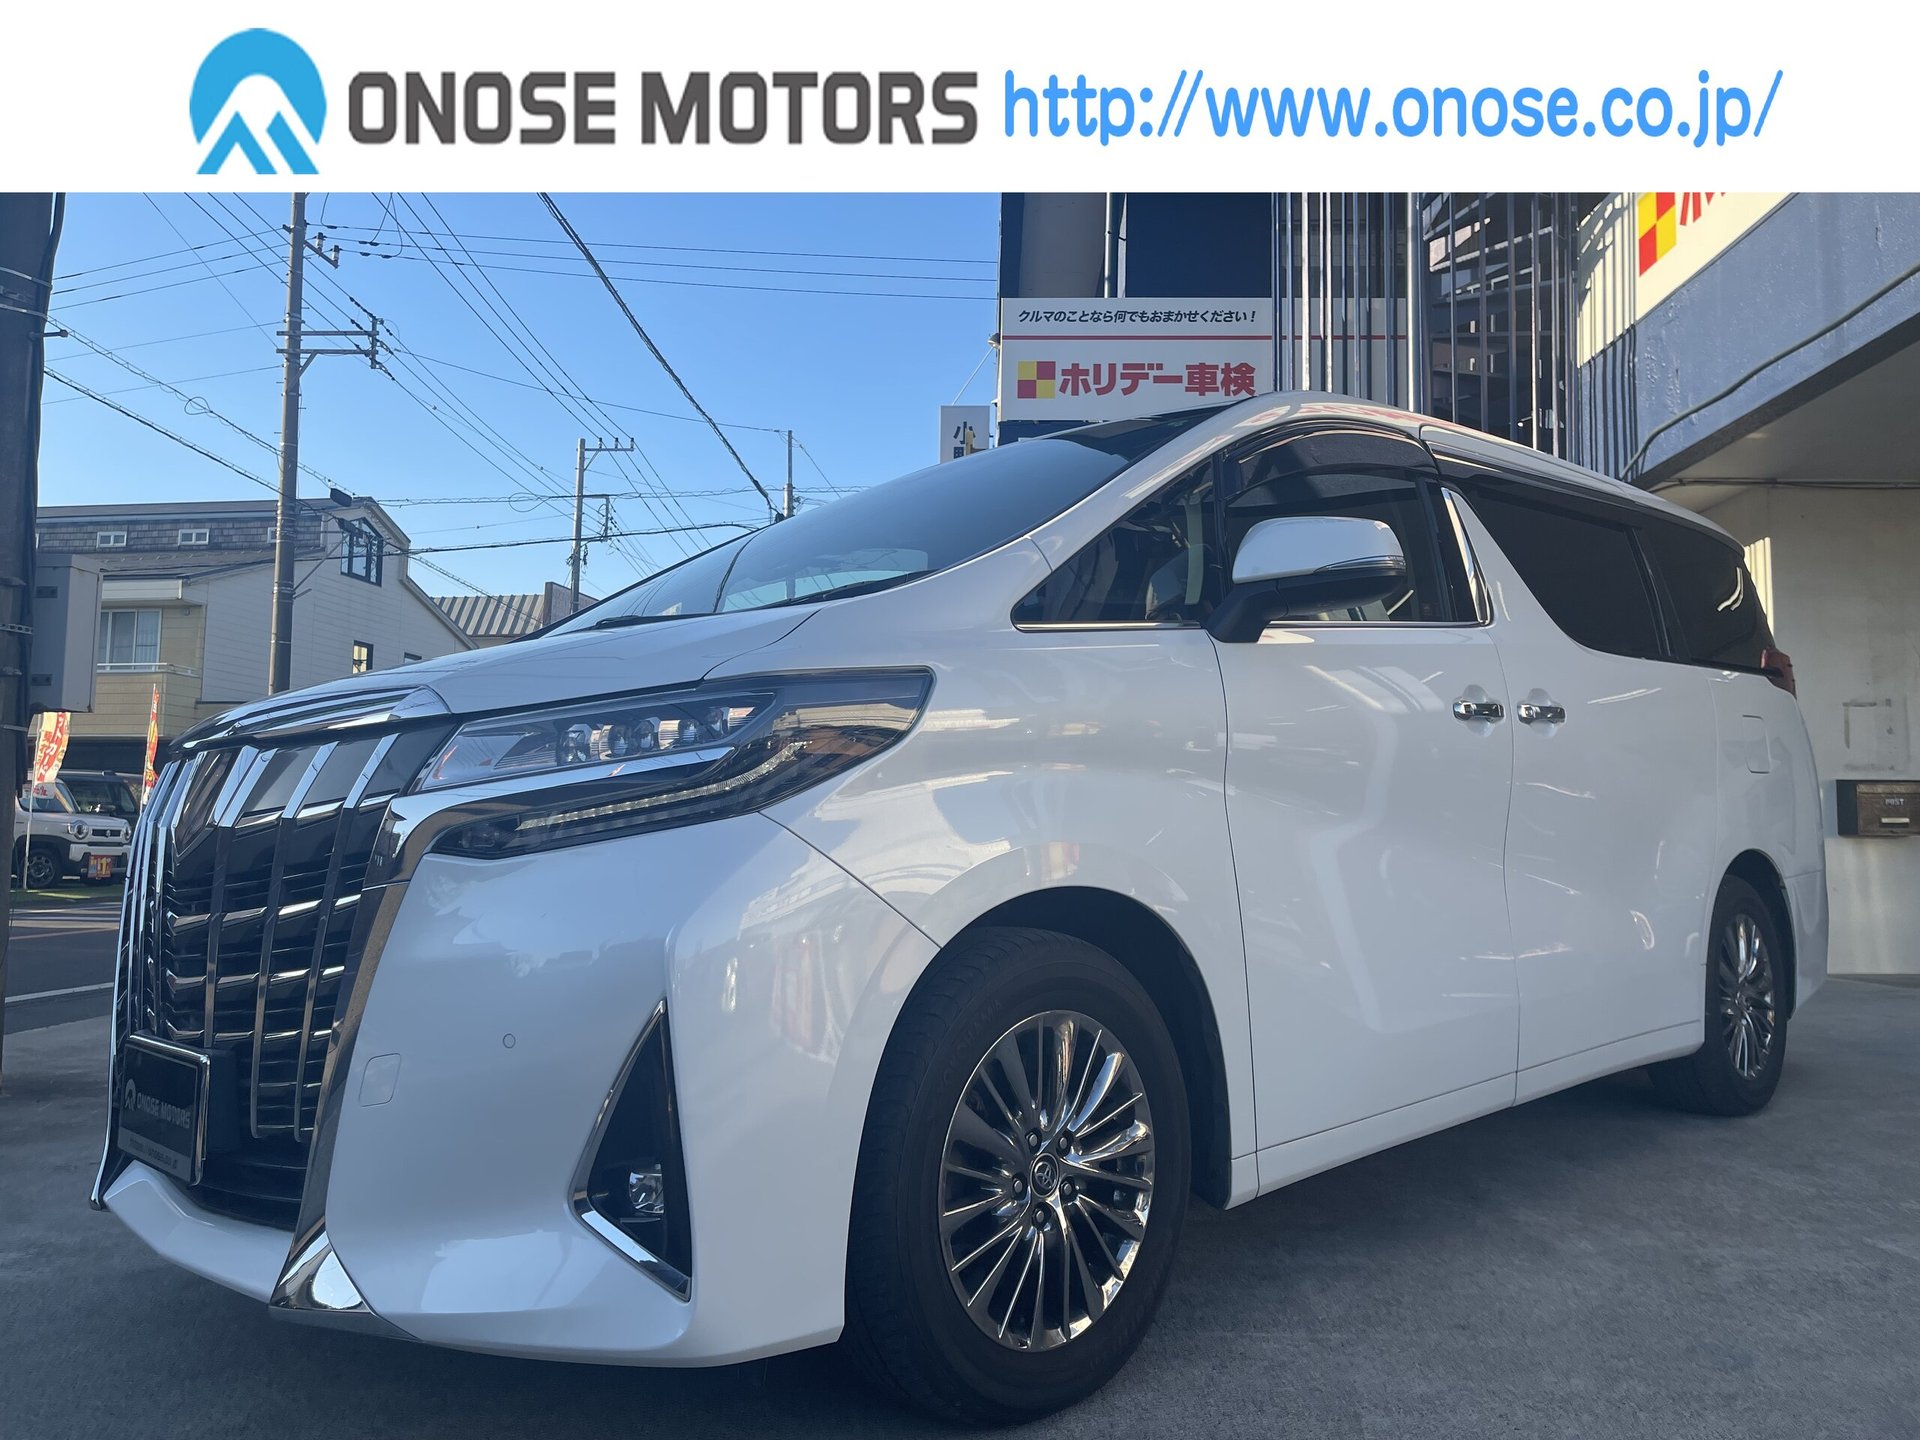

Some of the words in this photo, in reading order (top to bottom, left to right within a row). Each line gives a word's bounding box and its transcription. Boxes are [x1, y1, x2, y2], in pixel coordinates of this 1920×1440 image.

[1018, 309, 1257, 324] クルマのことなら何でもおまかせください！
[1059, 362, 1257, 397] ホリデー車検
[136, 1091, 160, 1117] ONOSE
[160, 1101, 192, 1129] MOTORS
